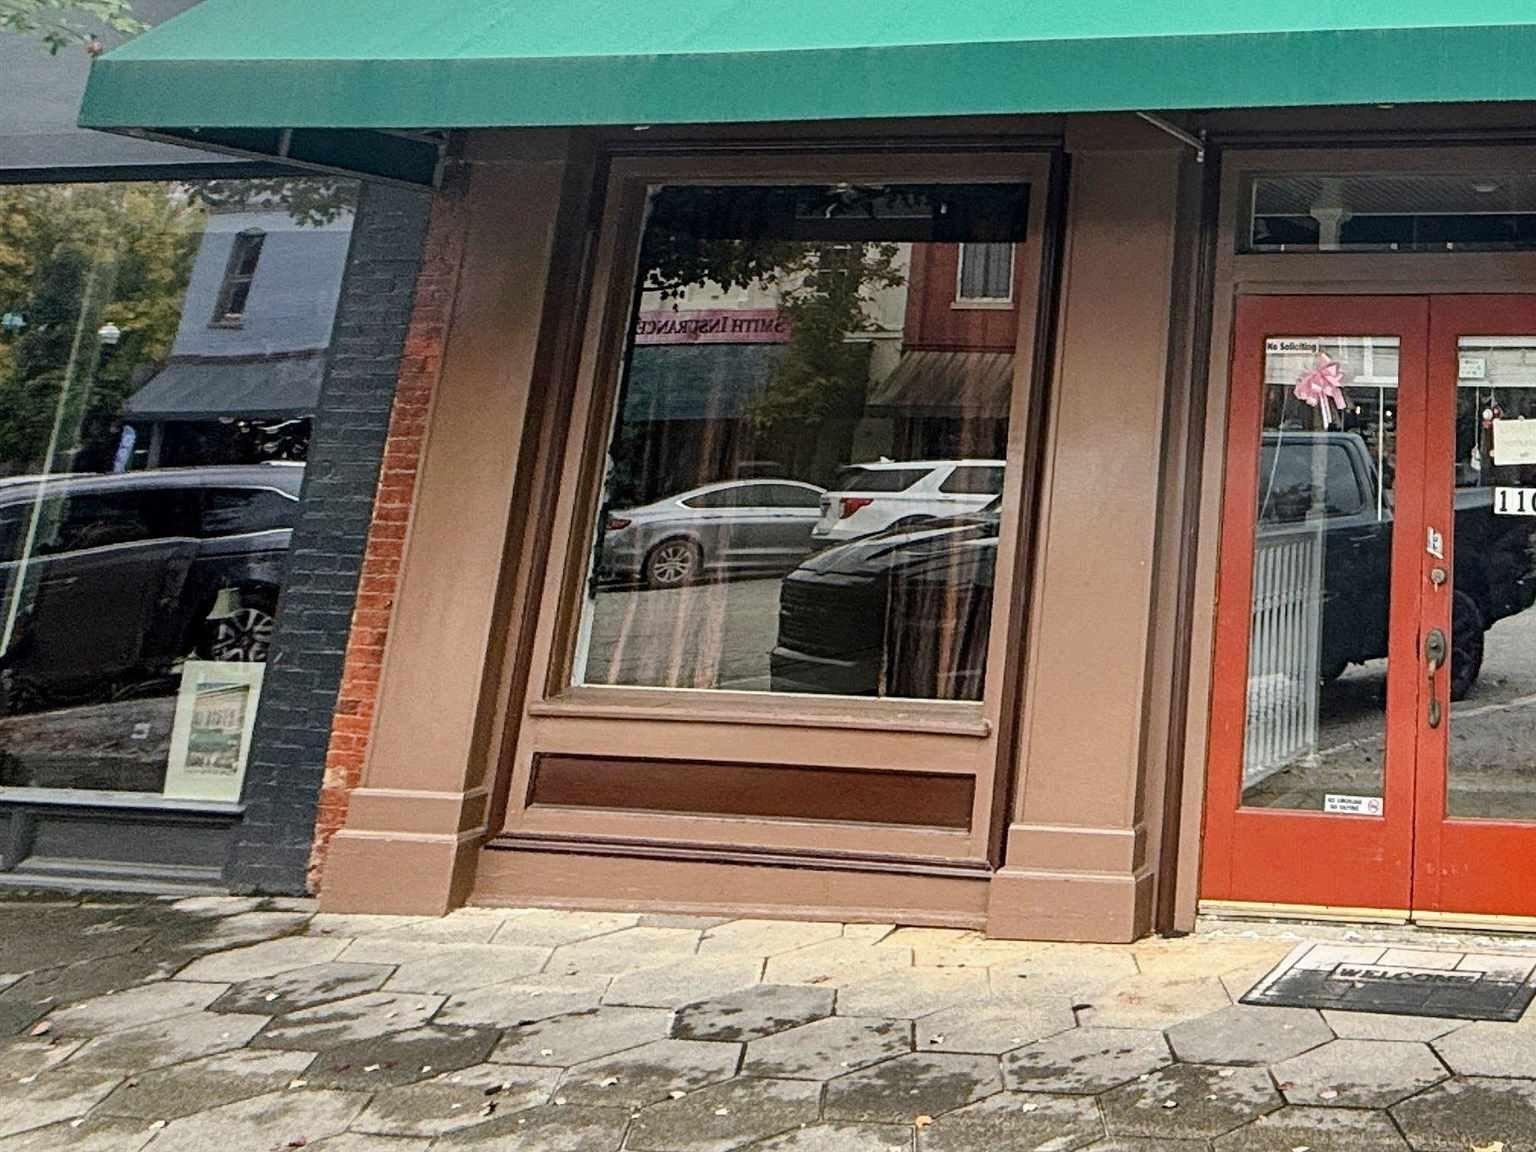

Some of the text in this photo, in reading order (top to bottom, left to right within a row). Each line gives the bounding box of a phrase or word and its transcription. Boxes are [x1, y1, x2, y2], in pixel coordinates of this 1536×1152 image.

[1267, 341, 1317, 352] No Soliciting
[1339, 967, 1478, 986] WELCOME
